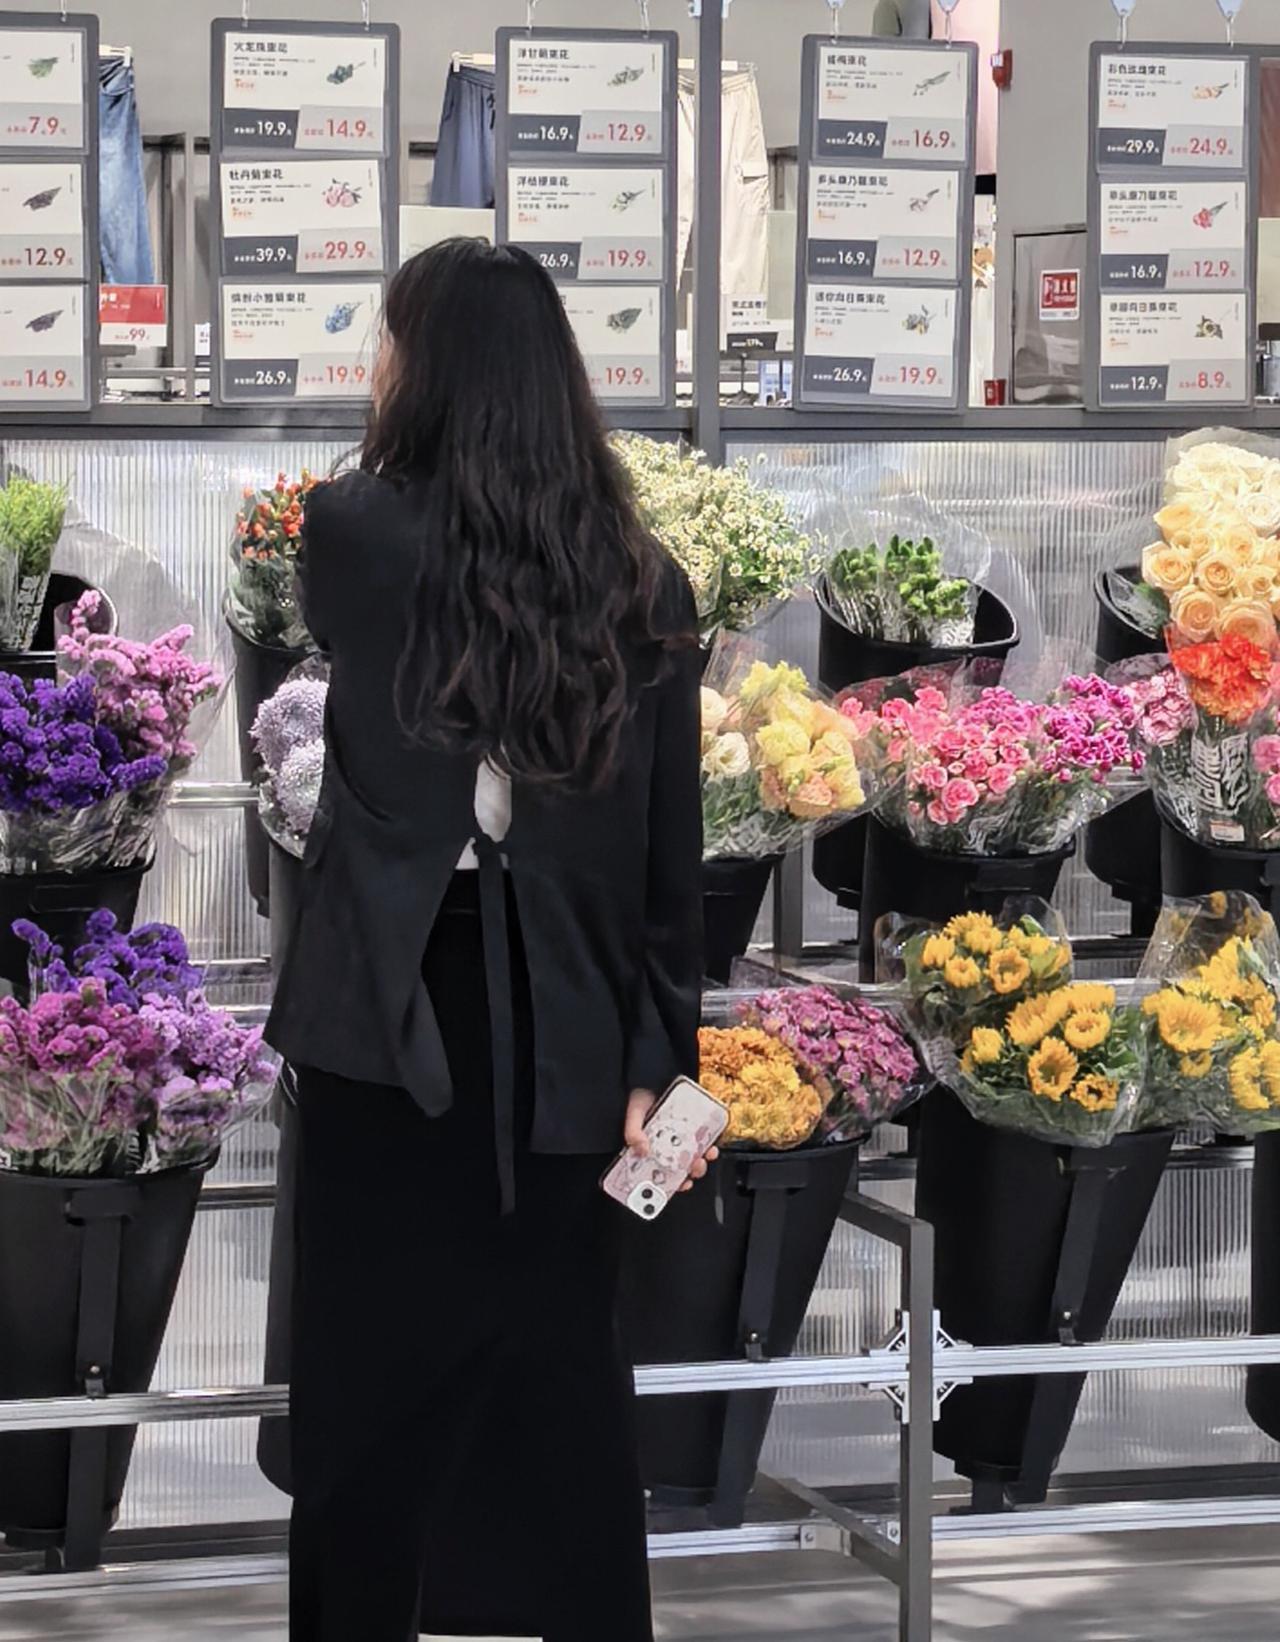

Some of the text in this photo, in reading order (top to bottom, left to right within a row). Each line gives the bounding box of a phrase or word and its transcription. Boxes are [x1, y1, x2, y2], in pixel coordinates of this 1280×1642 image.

[28, 116, 60, 135] 7.9
[256, 121, 287, 136] 19.9
[327, 118, 366, 137] 14.9
[539, 125, 569, 140] 16.9
[608, 122, 646, 142] 12.9
[846, 131, 876, 146] 24.9
[913, 129, 951, 148] 16.9
[1126, 139, 1155, 154] 29.9
[1189, 137, 1228, 156] 24.9
[24, 247, 66, 267] 12.9
[255, 247, 287, 262] 39.9
[325, 240, 366, 260] 29.9
[608, 249, 646, 268] 19.9
[838, 250, 866, 265] 16.9
[903, 247, 941, 267] 12.9
[1130, 264, 1158, 279] 16.9
[1193, 260, 1230, 279] 12.9
[129, 328, 146, 341] 99
[25, 369, 67, 389] 14.9
[255, 370, 287, 385] 26.9
[326, 364, 366, 384] 19.9
[606, 367, 644, 386] 19.9
[833, 367, 862, 383] 26.9
[900, 366, 938, 385] 19.9
[1130, 376, 1158, 390] 12.9
[1197, 371, 1225, 389] 8.9
